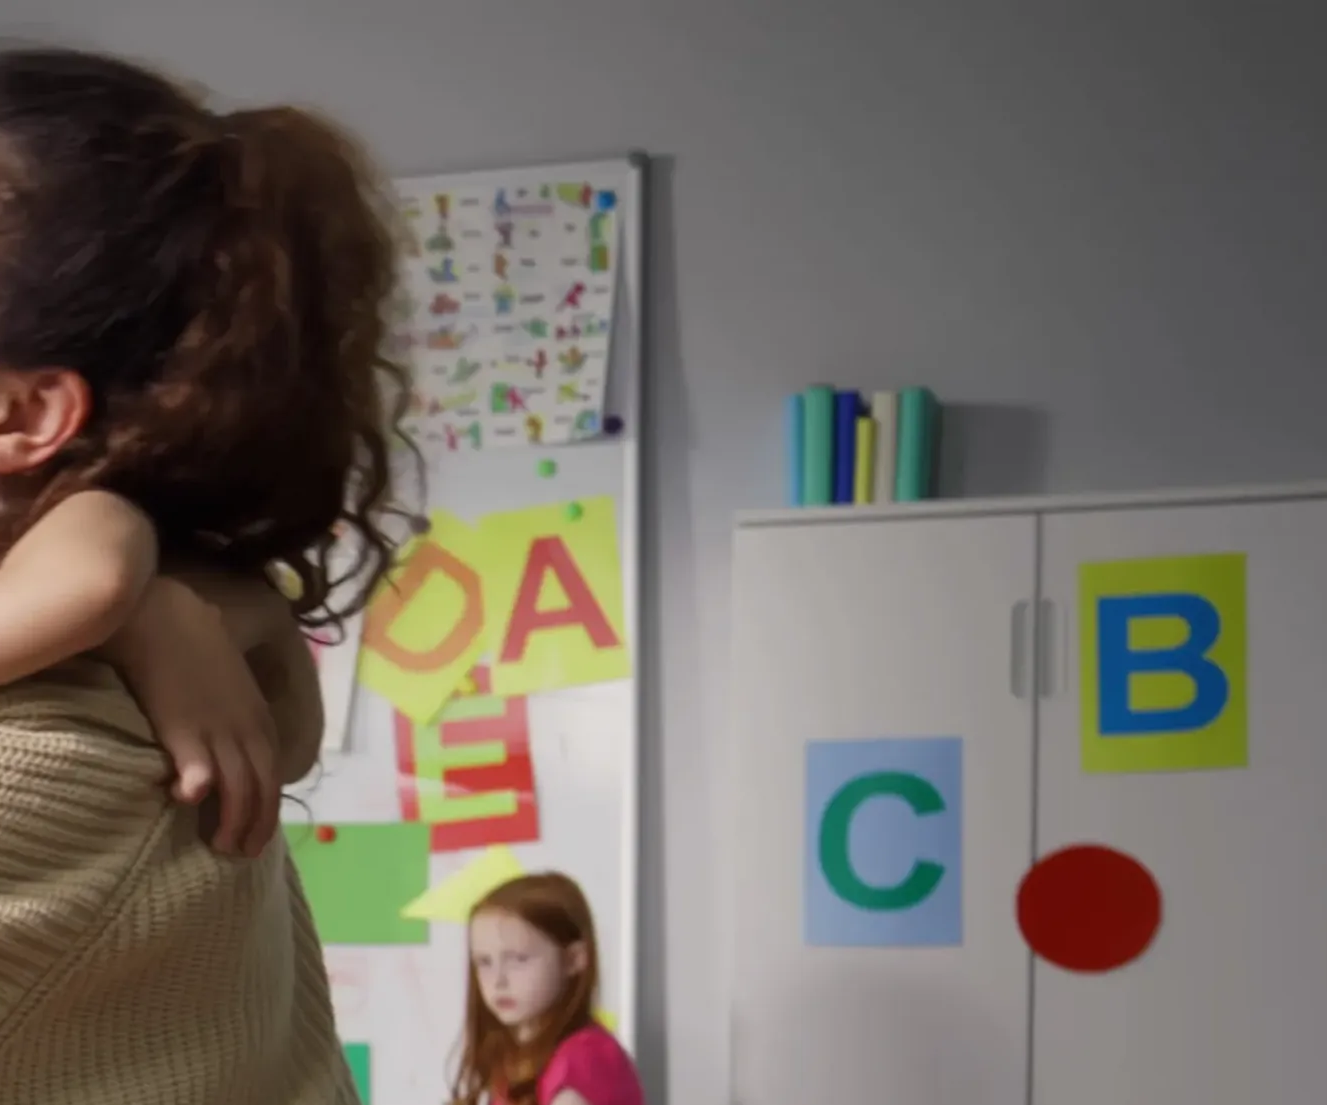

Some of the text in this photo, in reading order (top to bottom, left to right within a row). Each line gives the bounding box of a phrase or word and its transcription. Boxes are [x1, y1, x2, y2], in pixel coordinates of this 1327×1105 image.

[365, 540, 485, 672] D
[500, 535, 622, 664] A
[1096, 592, 1230, 737] B
[412, 692, 518, 822] E
[816, 770, 947, 913] C
